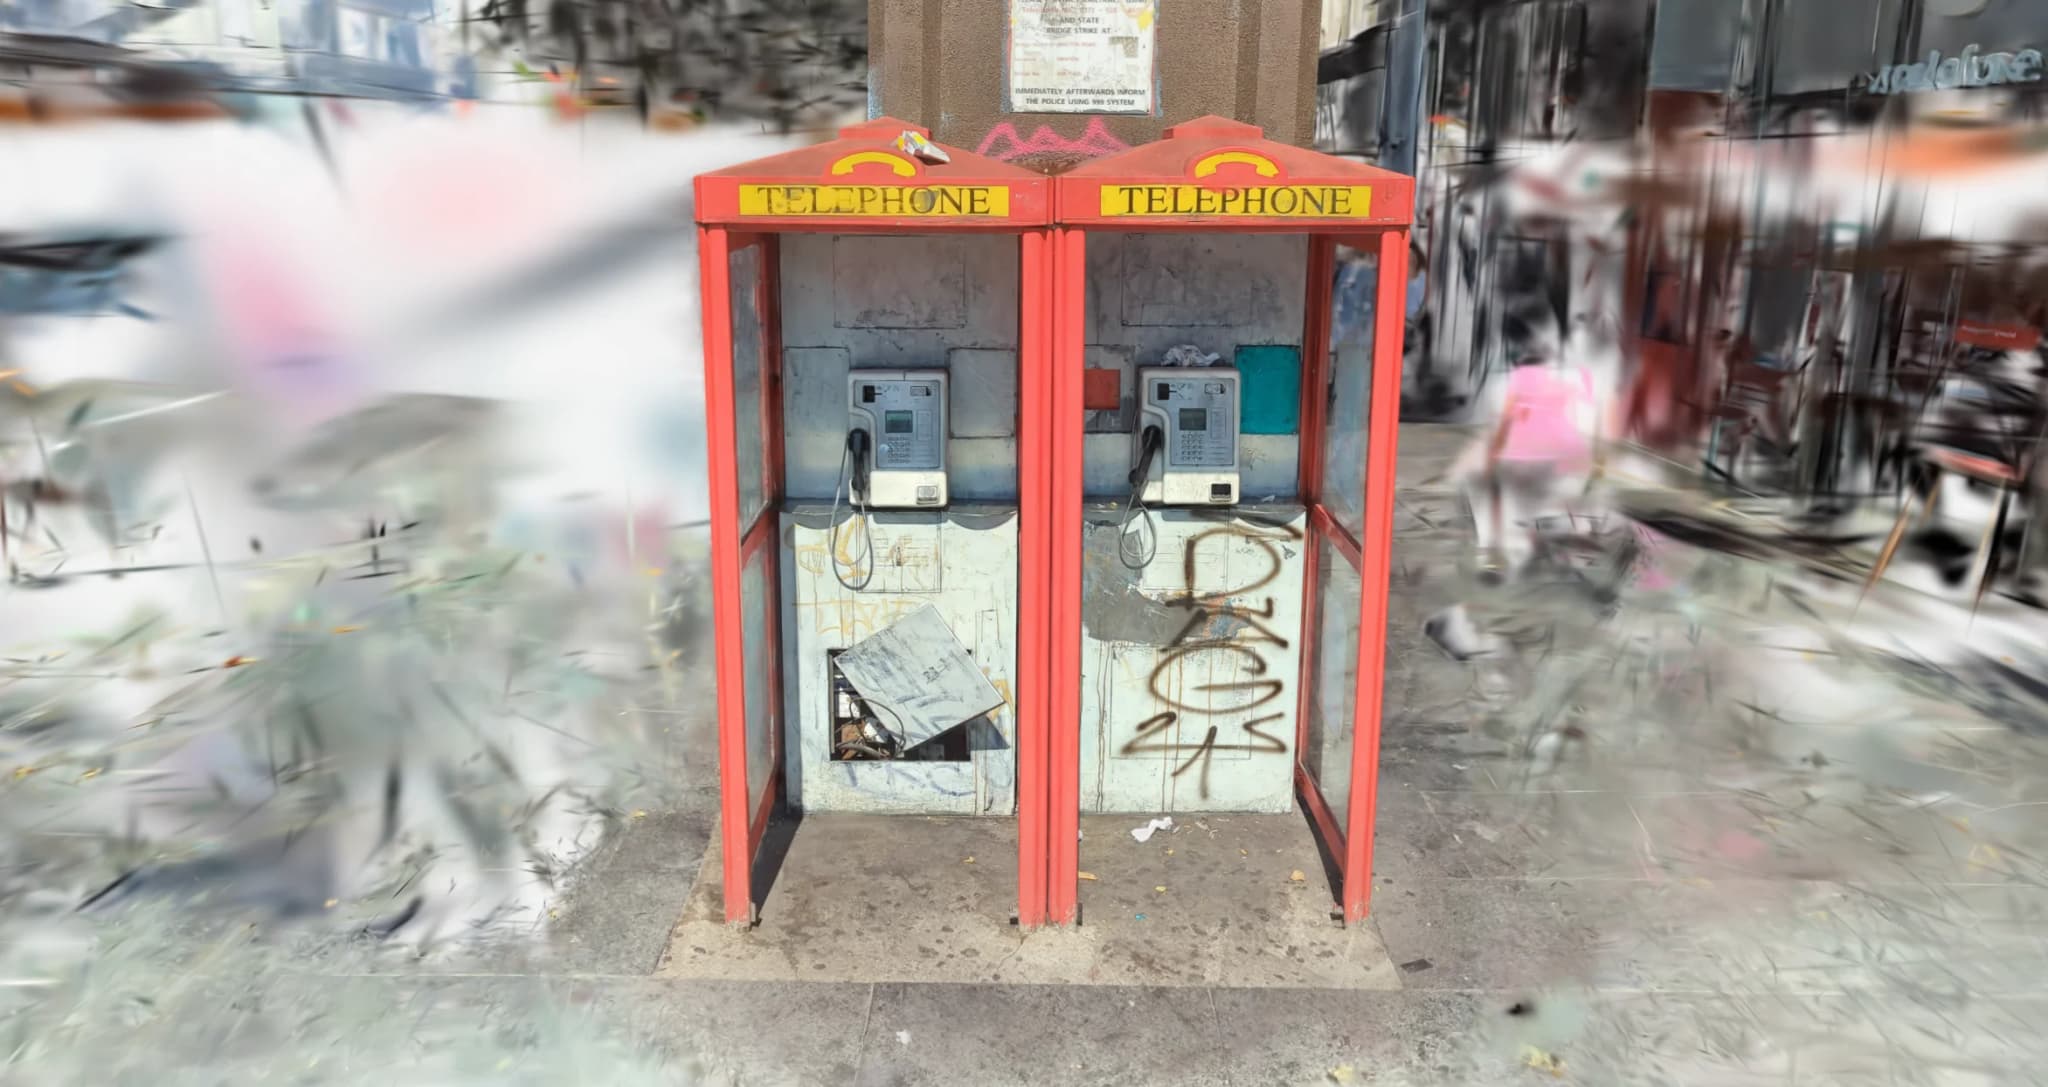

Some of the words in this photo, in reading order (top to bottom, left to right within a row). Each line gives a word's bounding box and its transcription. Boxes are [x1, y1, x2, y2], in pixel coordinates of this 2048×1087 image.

[1015, 87, 1063, 95] IMMEDIATELY
[1066, 88, 1115, 96] AFTERWARDS
[1117, 88, 1146, 96] INFORM
[757, 186, 990, 215] TELEPHONE
[1119, 186, 1352, 215] TELEPHONE
